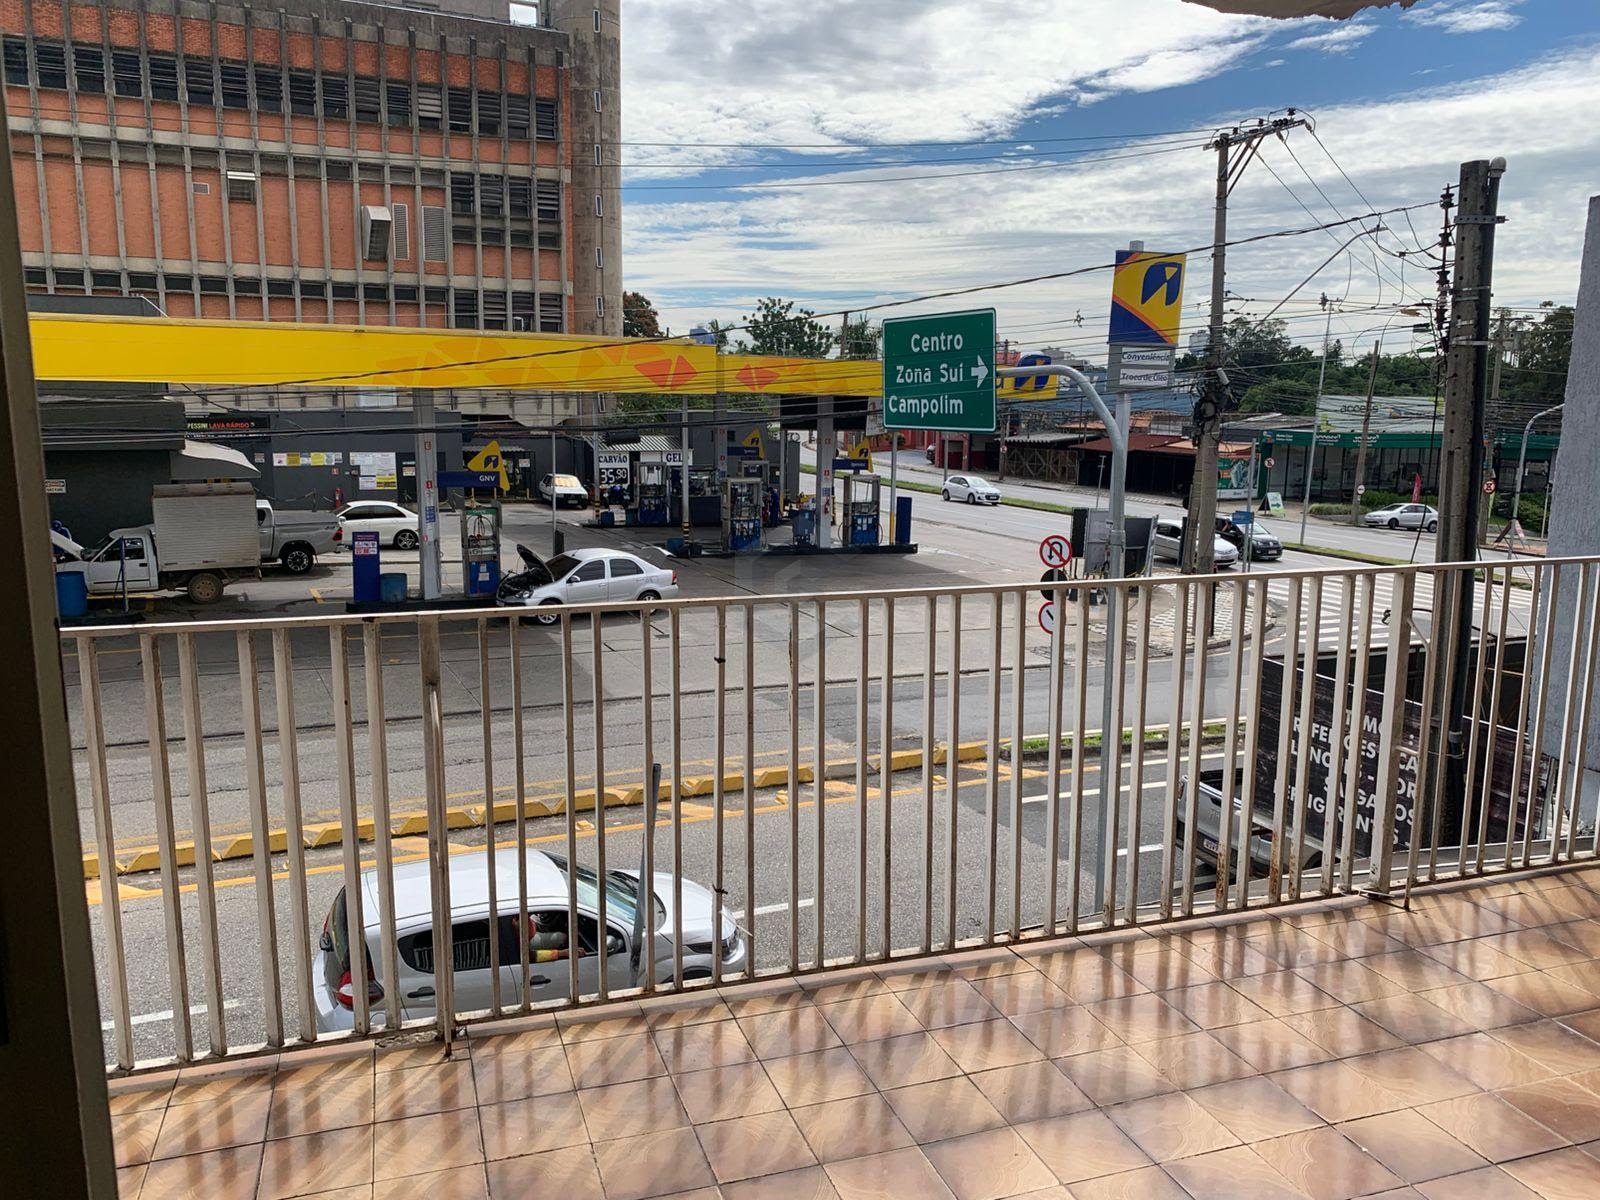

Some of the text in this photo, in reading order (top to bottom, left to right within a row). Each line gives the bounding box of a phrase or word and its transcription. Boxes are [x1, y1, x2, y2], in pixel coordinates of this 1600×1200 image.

[911, 332, 963, 353] Centro
[896, 362, 963, 384] Zona Sul
[888, 395, 963, 419] Campolim
[598, 453, 628, 464] CARVÃO
